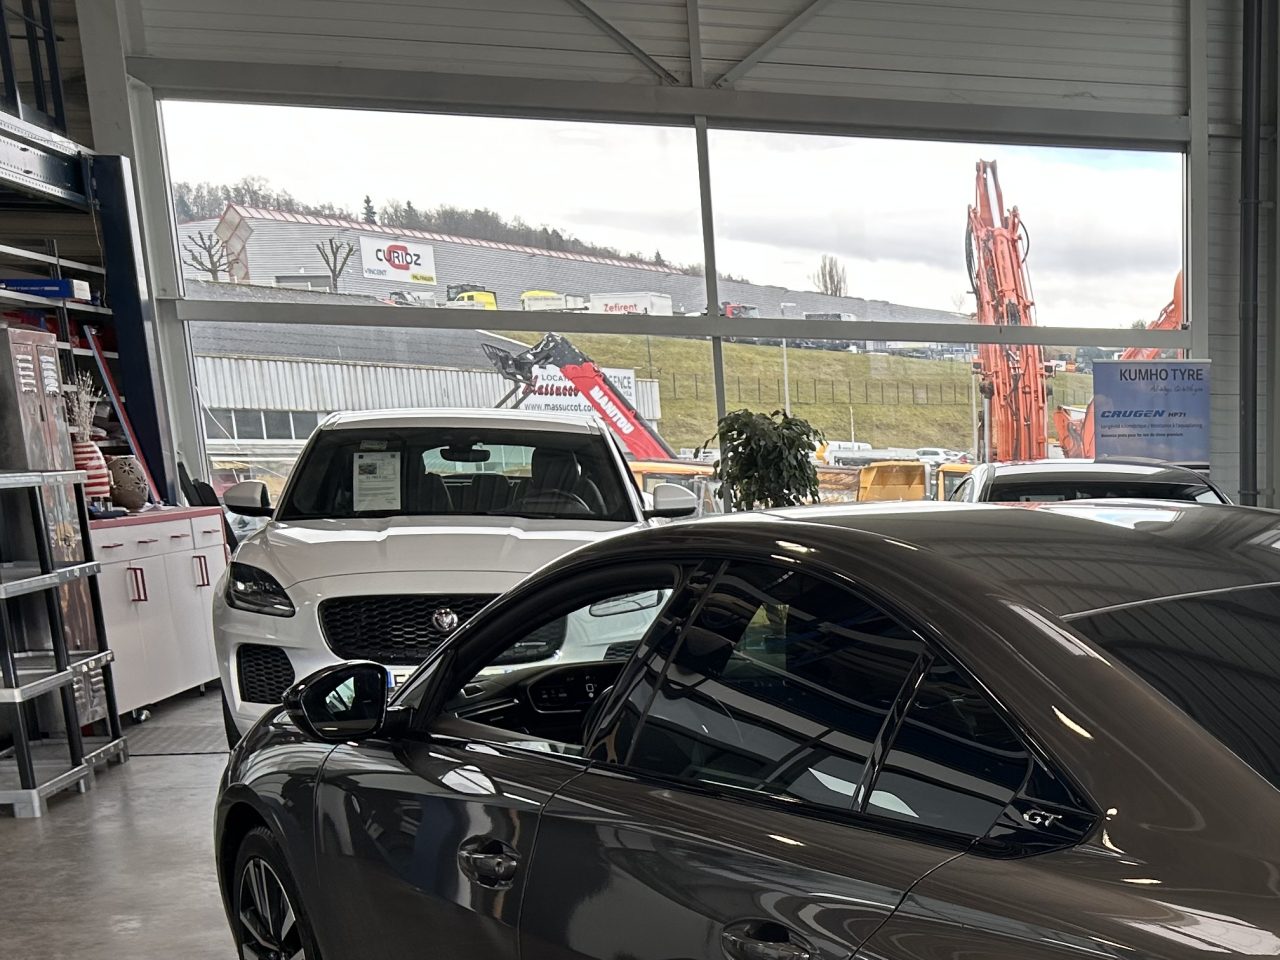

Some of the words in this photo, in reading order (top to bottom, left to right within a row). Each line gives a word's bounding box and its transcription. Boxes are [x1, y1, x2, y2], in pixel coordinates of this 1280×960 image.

[375, 248, 421, 266] CURIOZ
[1119, 368, 1169, 381] KUMHO
[1171, 368, 1203, 381] TYRE
[589, 385, 634, 435] MANITOU
[1101, 410, 1166, 418] CRUGEN
[1023, 810, 1062, 827] GT
